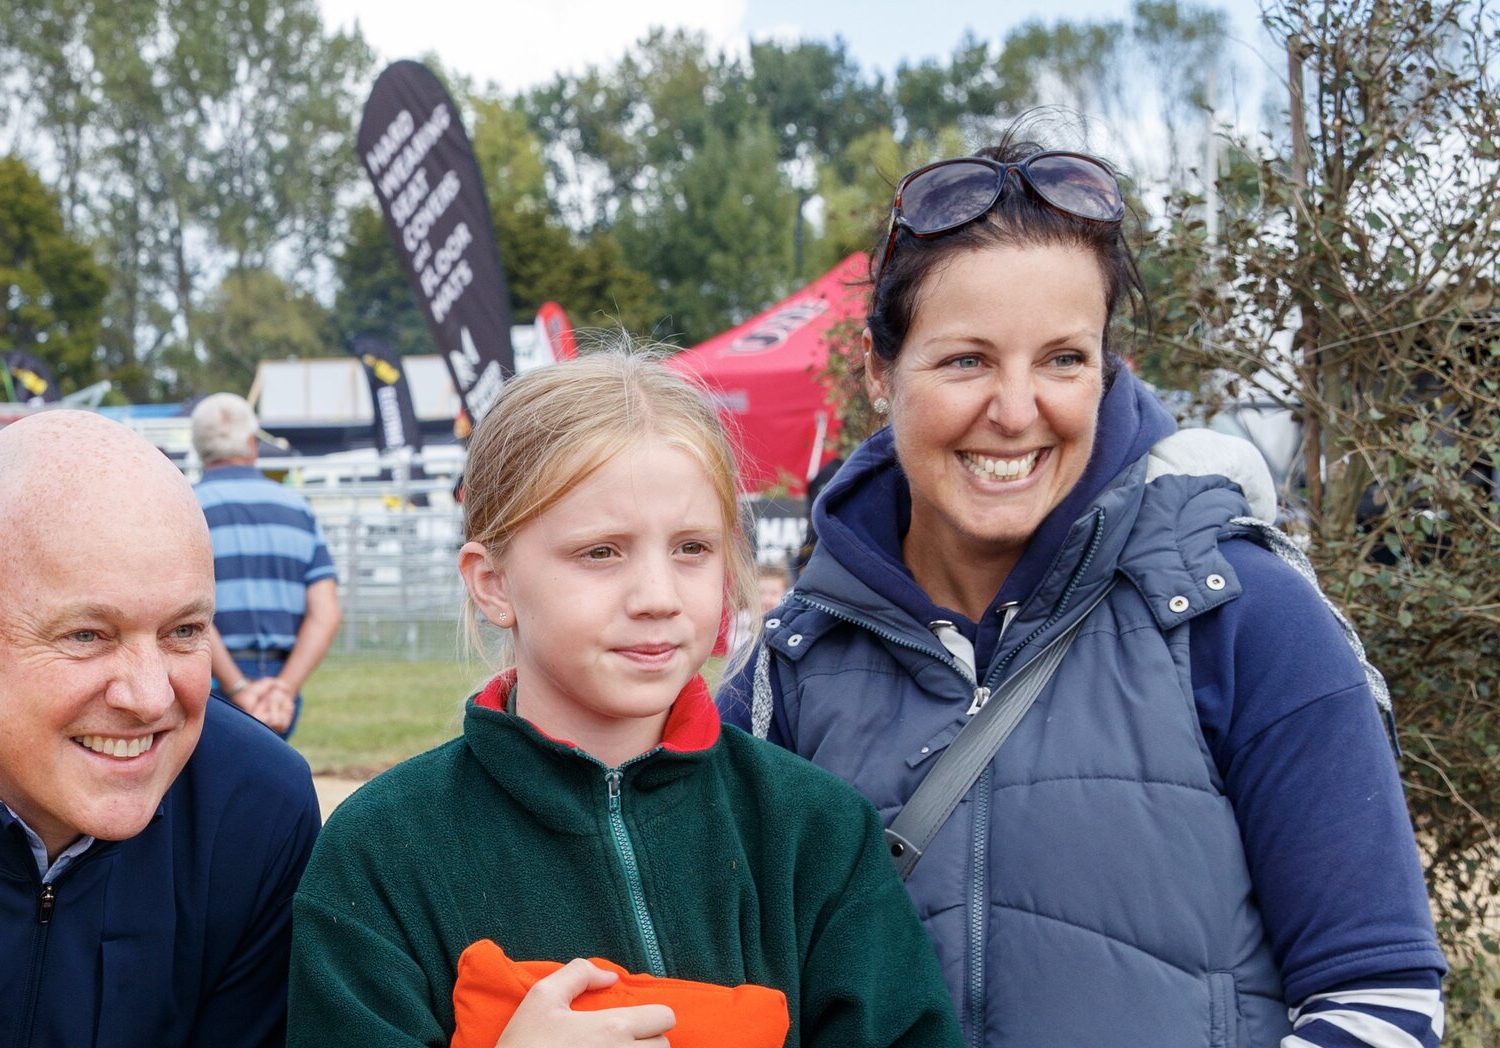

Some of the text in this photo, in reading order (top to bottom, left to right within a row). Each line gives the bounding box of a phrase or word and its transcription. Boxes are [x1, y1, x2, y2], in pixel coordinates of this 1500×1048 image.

[366, 109, 414, 175] HARD
[378, 103, 450, 199] WEARING
[391, 167, 429, 228] SEAT
[403, 170, 461, 251] COVERS
[420, 222, 472, 297] FLOOR
[431, 260, 473, 323] MATS
